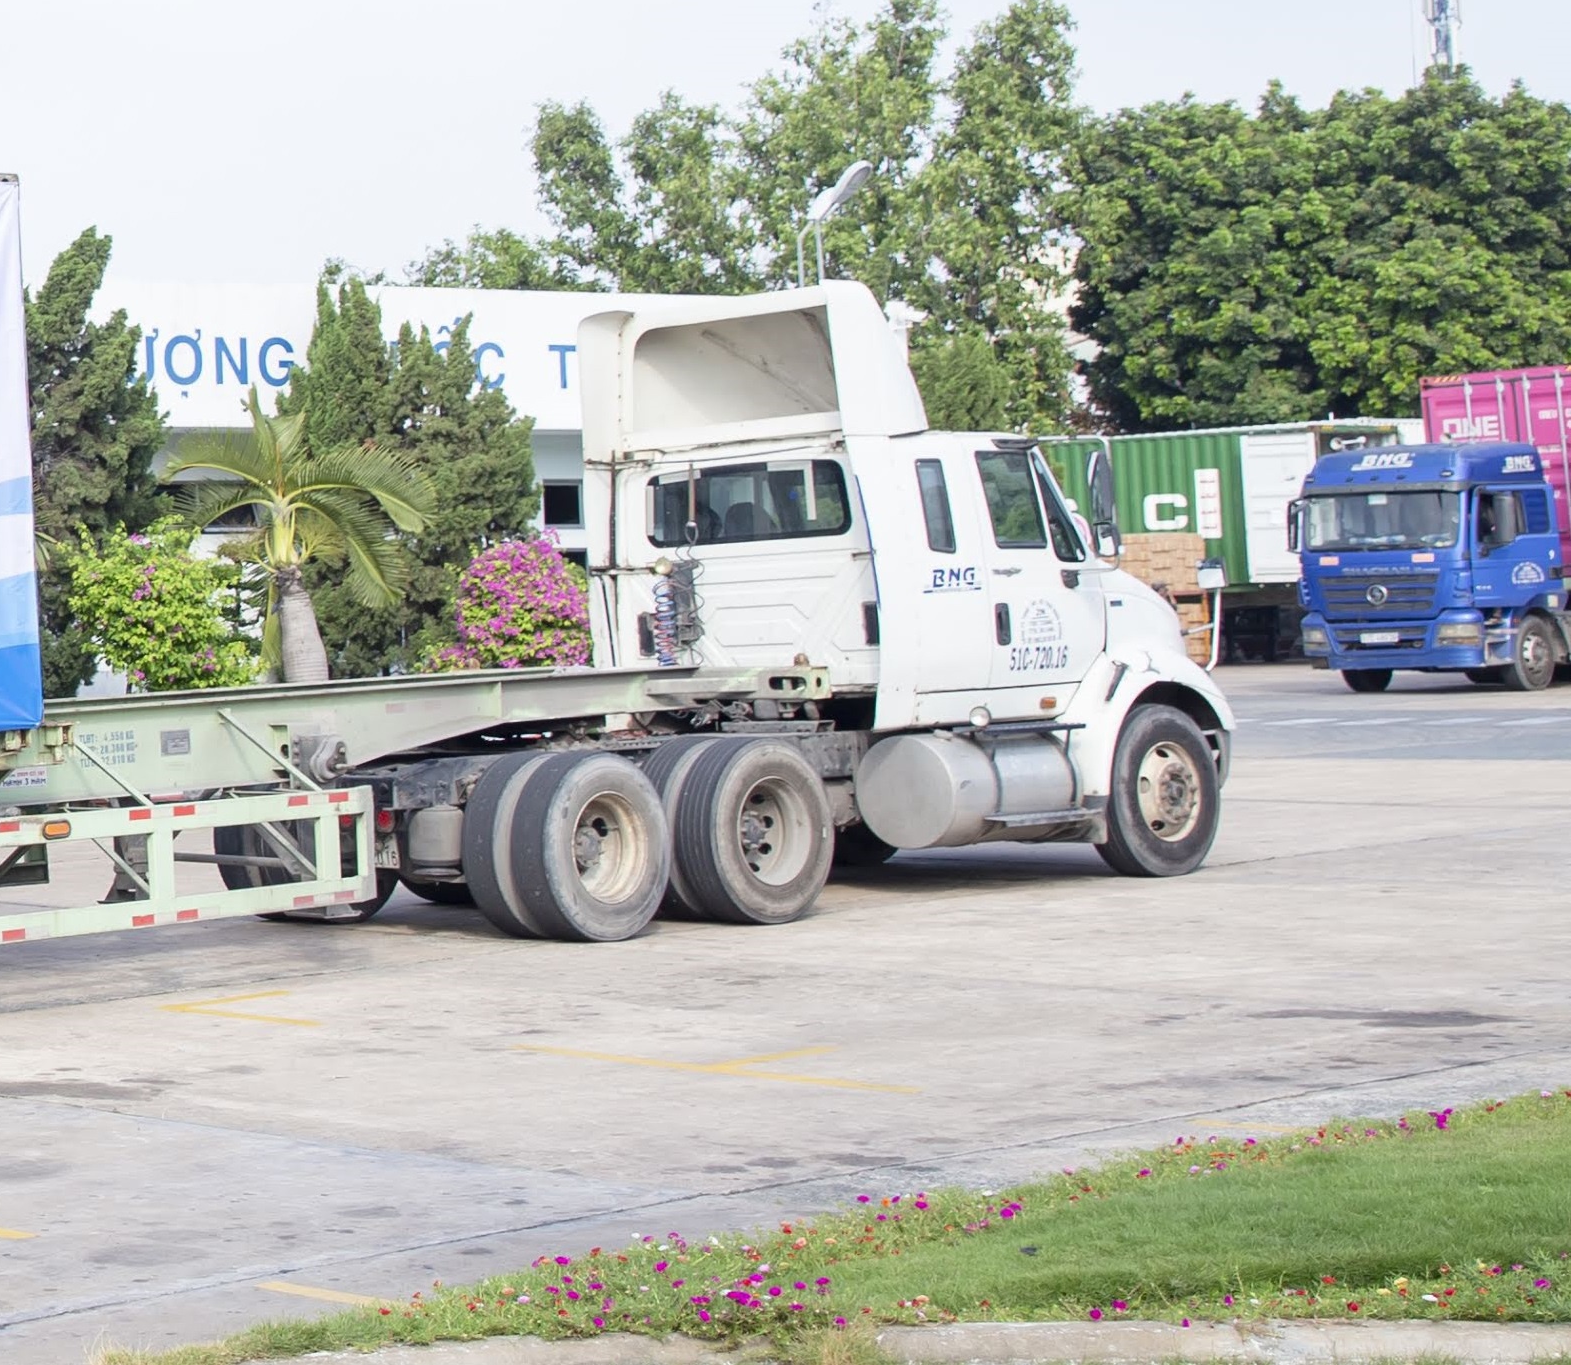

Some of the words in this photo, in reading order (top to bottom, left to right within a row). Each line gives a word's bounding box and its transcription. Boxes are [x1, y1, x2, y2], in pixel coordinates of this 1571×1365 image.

[127, 328, 295, 399] ƯỢNG
[1443, 415, 1500, 439] ONE
[933, 567, 976, 588] BNG
[1009, 645, 1069, 671] 51C-720.16
